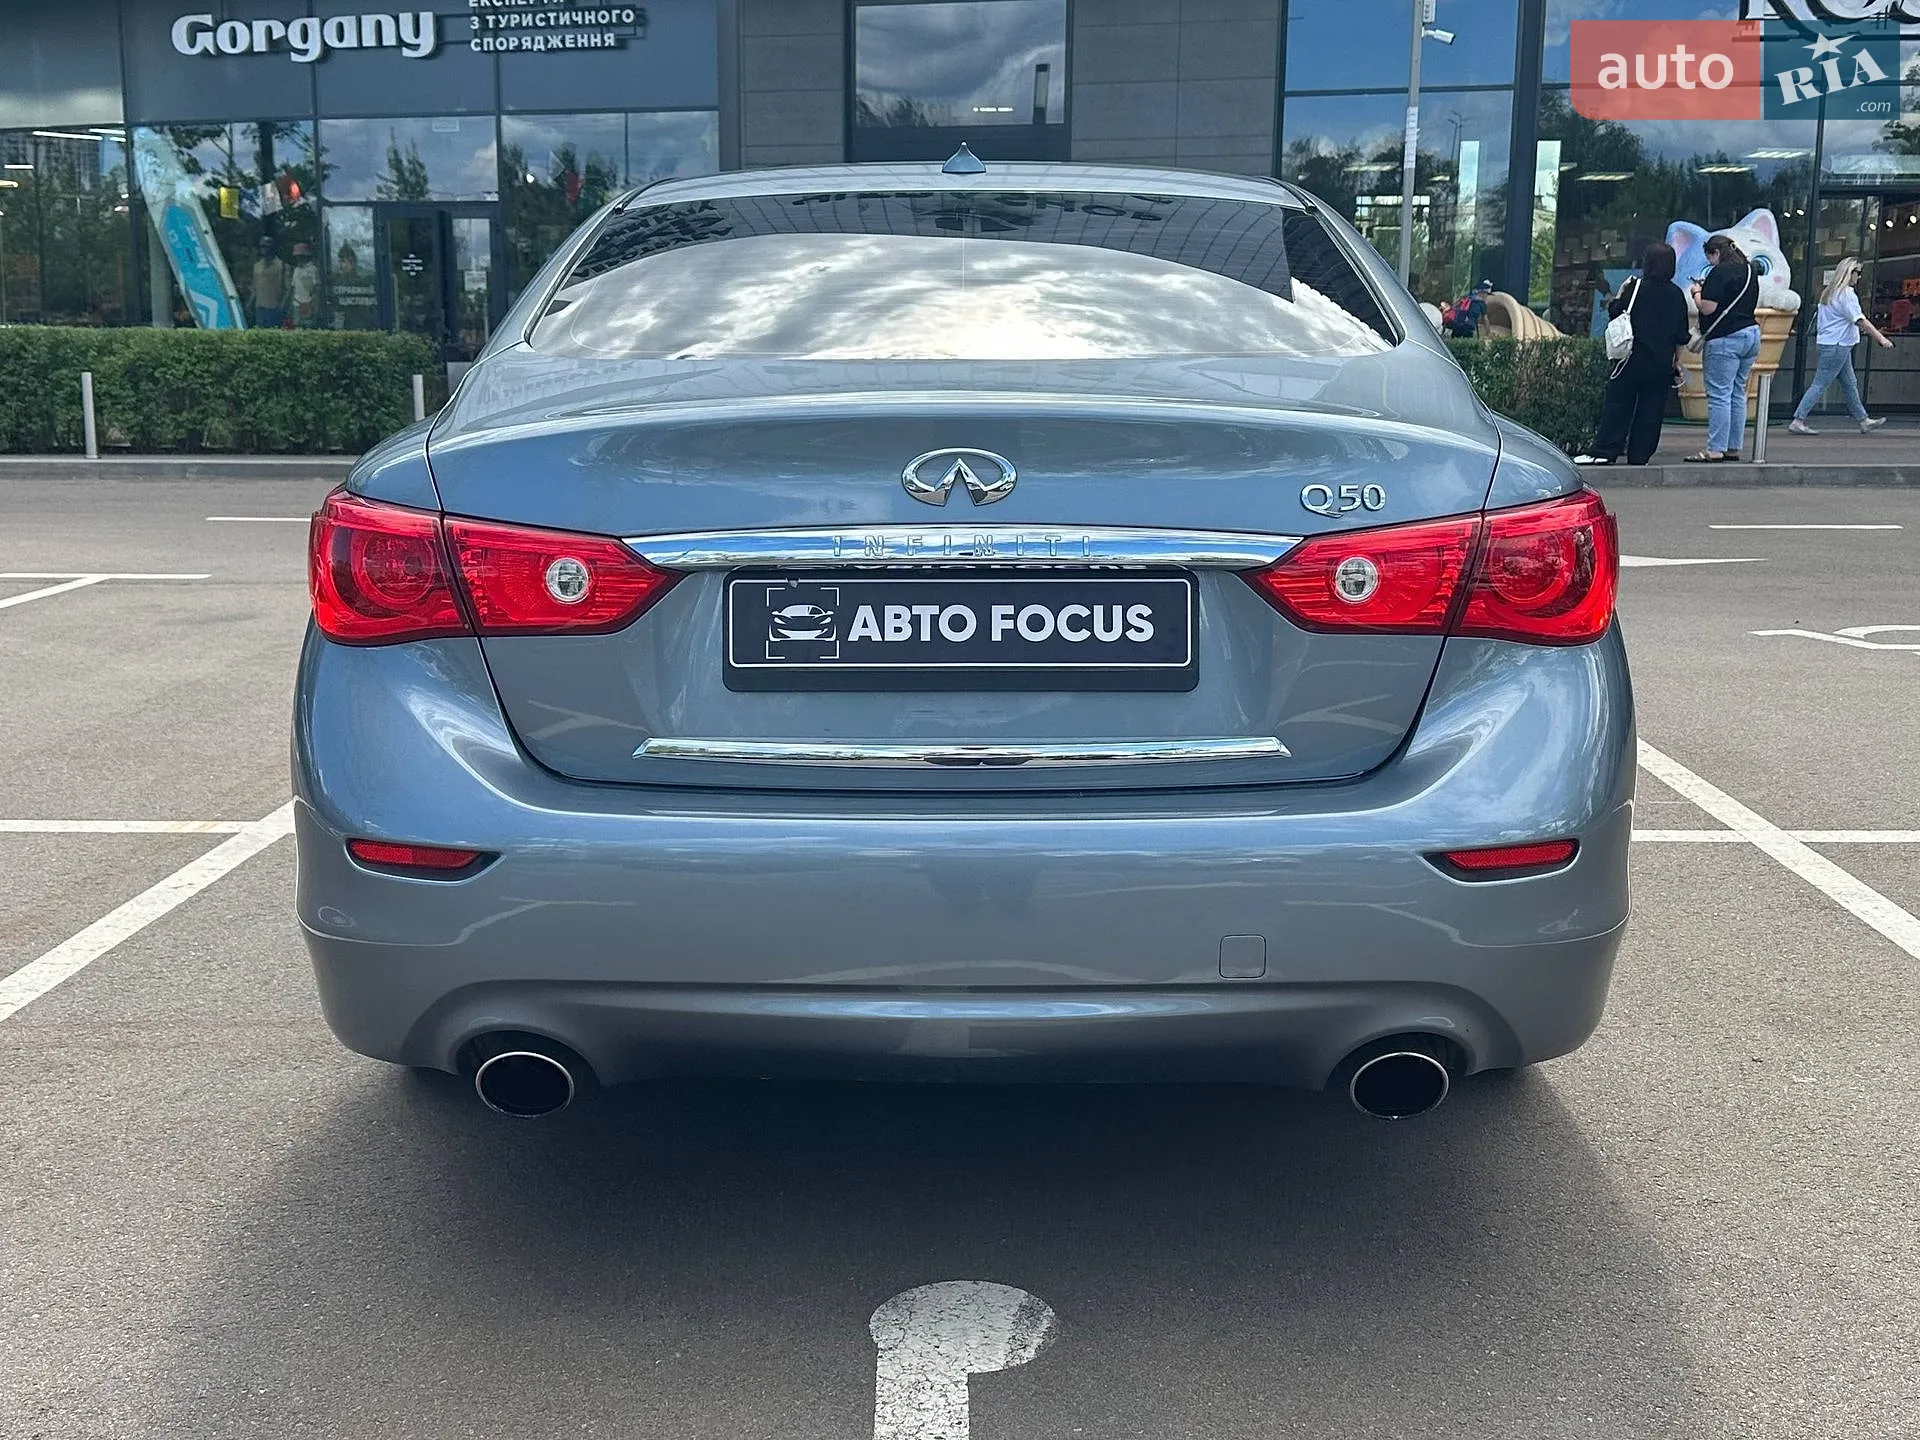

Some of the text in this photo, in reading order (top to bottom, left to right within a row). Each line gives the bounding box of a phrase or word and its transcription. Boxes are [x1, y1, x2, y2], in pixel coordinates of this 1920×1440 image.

[486, 9, 635, 29] ТУРИСТИЧНОГО
[171, 11, 434, 62] Gorgany
[470, 33, 616, 51] СПОРЯДЖЕННЯ
[1301, 484, 1386, 519] Q50
[834, 535, 1090, 557] INFINITI
[991, 604, 1154, 642] FOCUS
